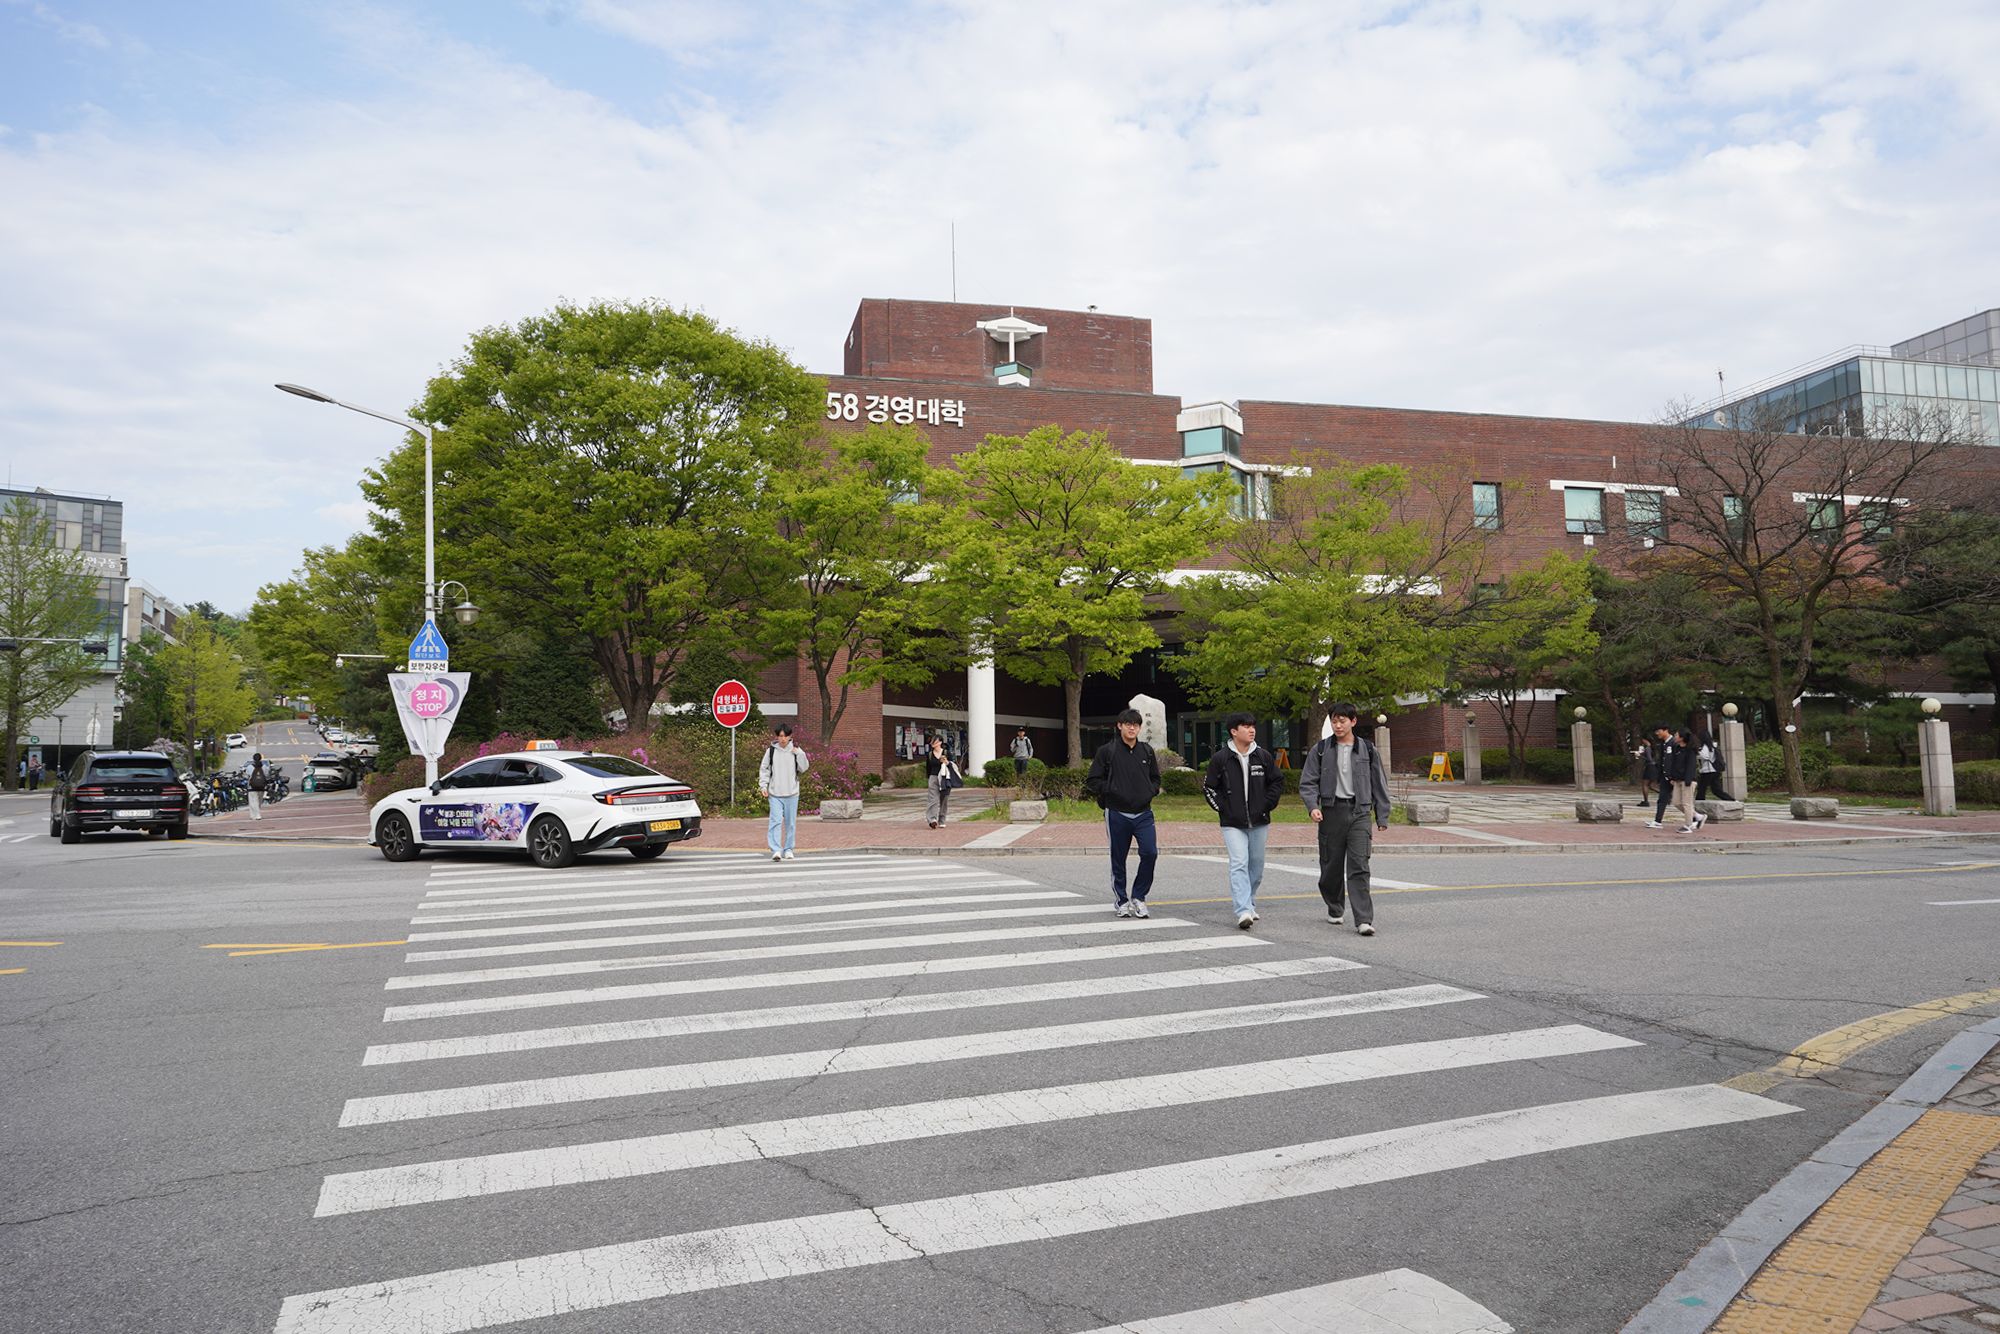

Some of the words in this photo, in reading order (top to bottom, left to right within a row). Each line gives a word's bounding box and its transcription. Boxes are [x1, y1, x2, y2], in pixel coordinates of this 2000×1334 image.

[826, 392, 860, 422] 58
[865, 395, 966, 428] 경영대학
[411, 662, 446, 671] 보행자우선
[716, 694, 746, 705] 대형버스
[416, 702, 443, 712] STOP
[719, 704, 744, 713] 진입금지
